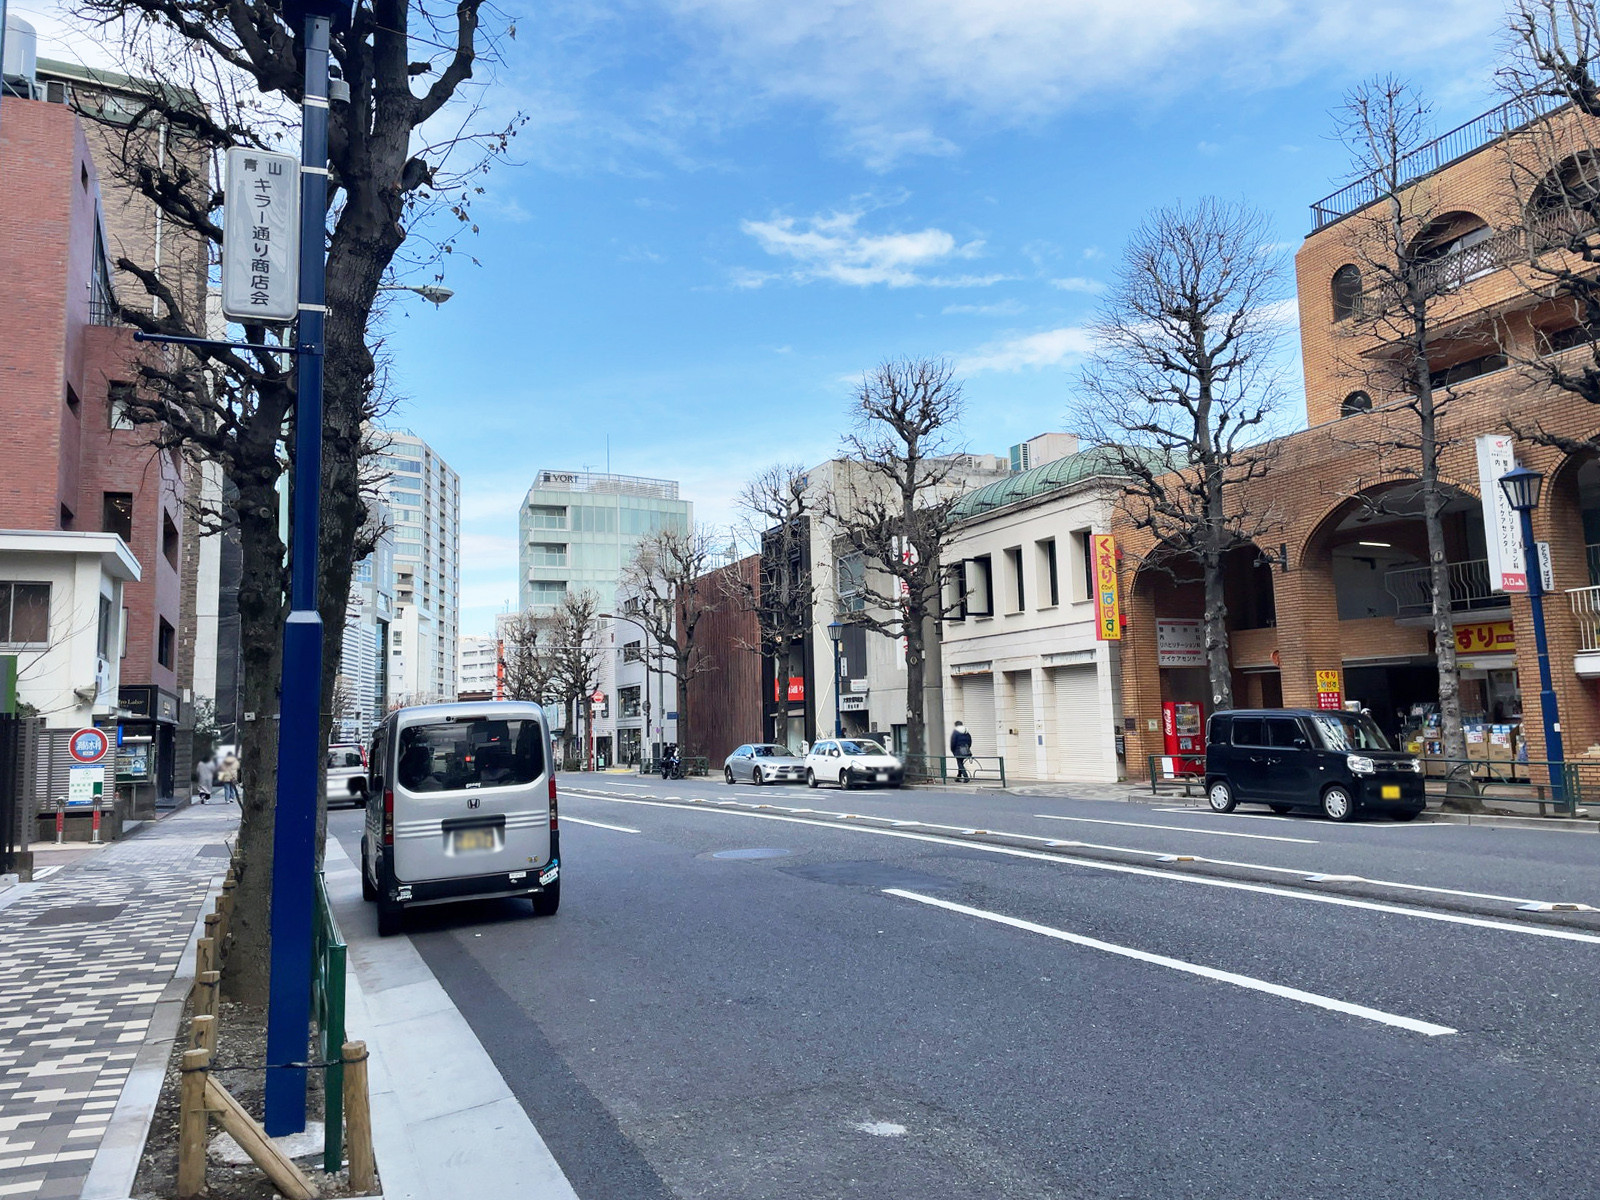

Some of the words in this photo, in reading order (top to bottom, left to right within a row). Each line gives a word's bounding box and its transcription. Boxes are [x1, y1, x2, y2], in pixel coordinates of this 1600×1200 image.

[243, 158, 282, 176] 青山
[250, 178, 272, 306] キラー通り商店会
[552, 474, 579, 484] VORT
[1100, 538, 1112, 583] くすり
[1503, 577, 1515, 586] 入口
[1102, 590, 1115, 632] ぱぱす
